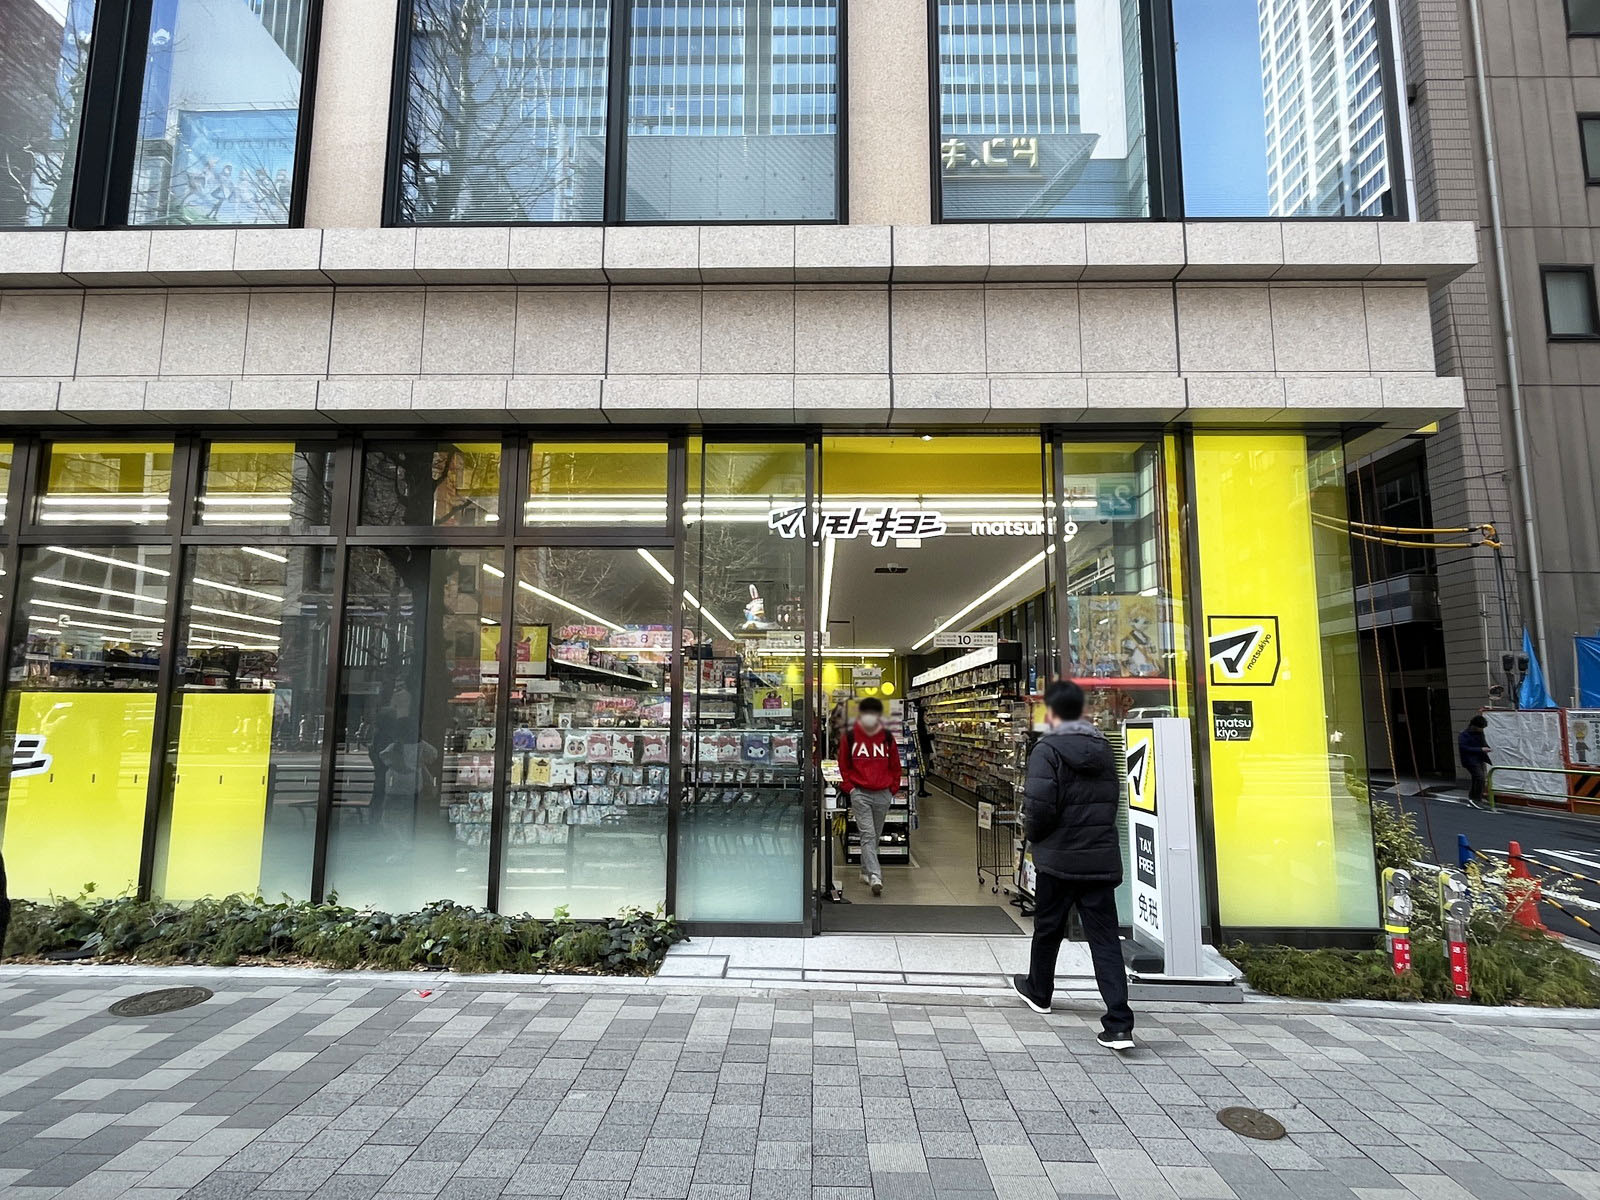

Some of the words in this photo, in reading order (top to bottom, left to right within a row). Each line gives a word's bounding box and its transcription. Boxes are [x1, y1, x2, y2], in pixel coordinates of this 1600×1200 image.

[971, 517, 1078, 536] matsukio
[641, 634, 648, 643] 8
[794, 634, 801, 644] 9
[958, 635, 971, 645] 10
[1247, 634, 1272, 670] matsukiyo
[1215, 718, 1252, 728] matsu
[1216, 727, 1239, 741] kiyo
[851, 742, 889, 757] AN
[1139, 837, 1152, 855] TAX
[1139, 855, 1155, 875] FREE
[1138, 892, 1159, 930] 免税
